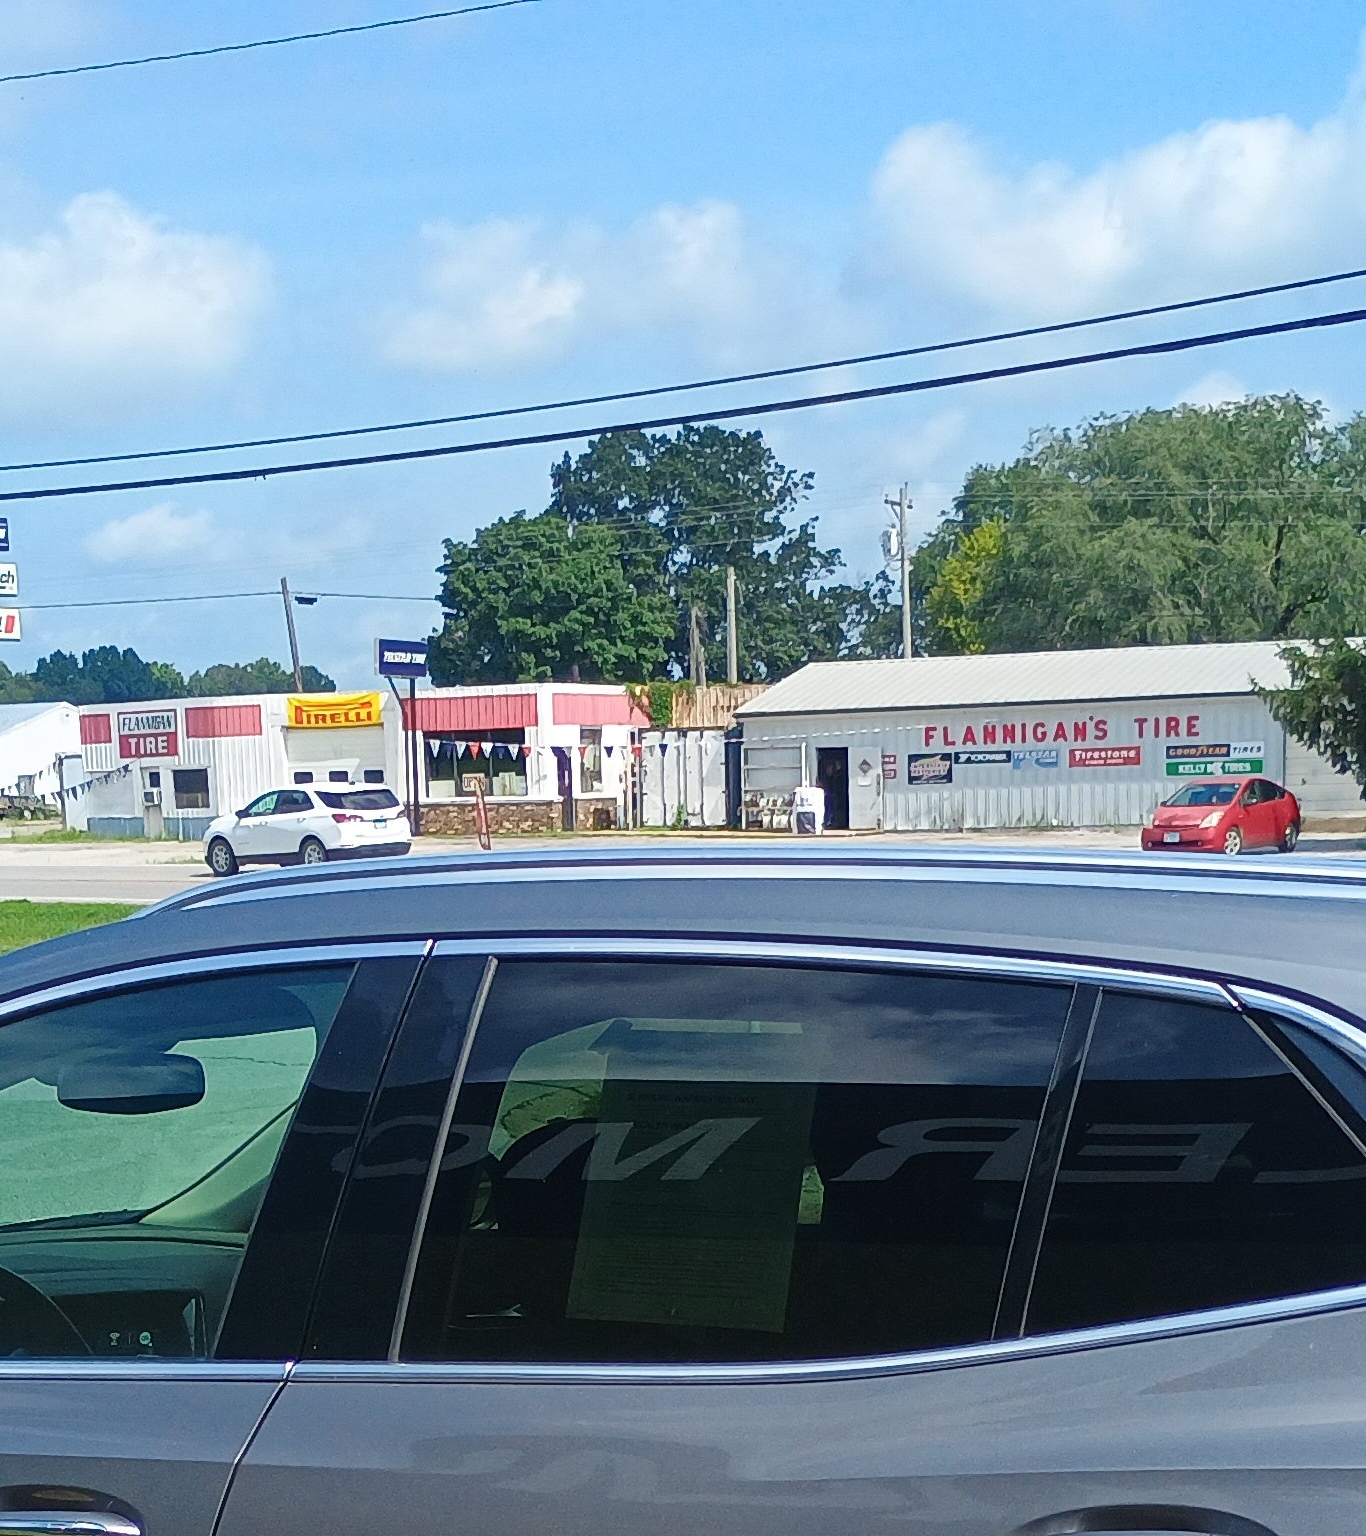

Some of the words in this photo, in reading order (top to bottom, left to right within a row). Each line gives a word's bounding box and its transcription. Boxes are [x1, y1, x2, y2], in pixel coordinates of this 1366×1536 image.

[294, 701, 373, 724] PIRELLI
[924, 714, 1108, 747] FLANNIGAN'S
[1134, 715, 1200, 739] TIRE
[128, 736, 168, 755] TIRE
[1168, 745, 1228, 757] GOODYEAR
[1232, 745, 1261, 754] TIRES
[463, 776, 485, 789] OPN
